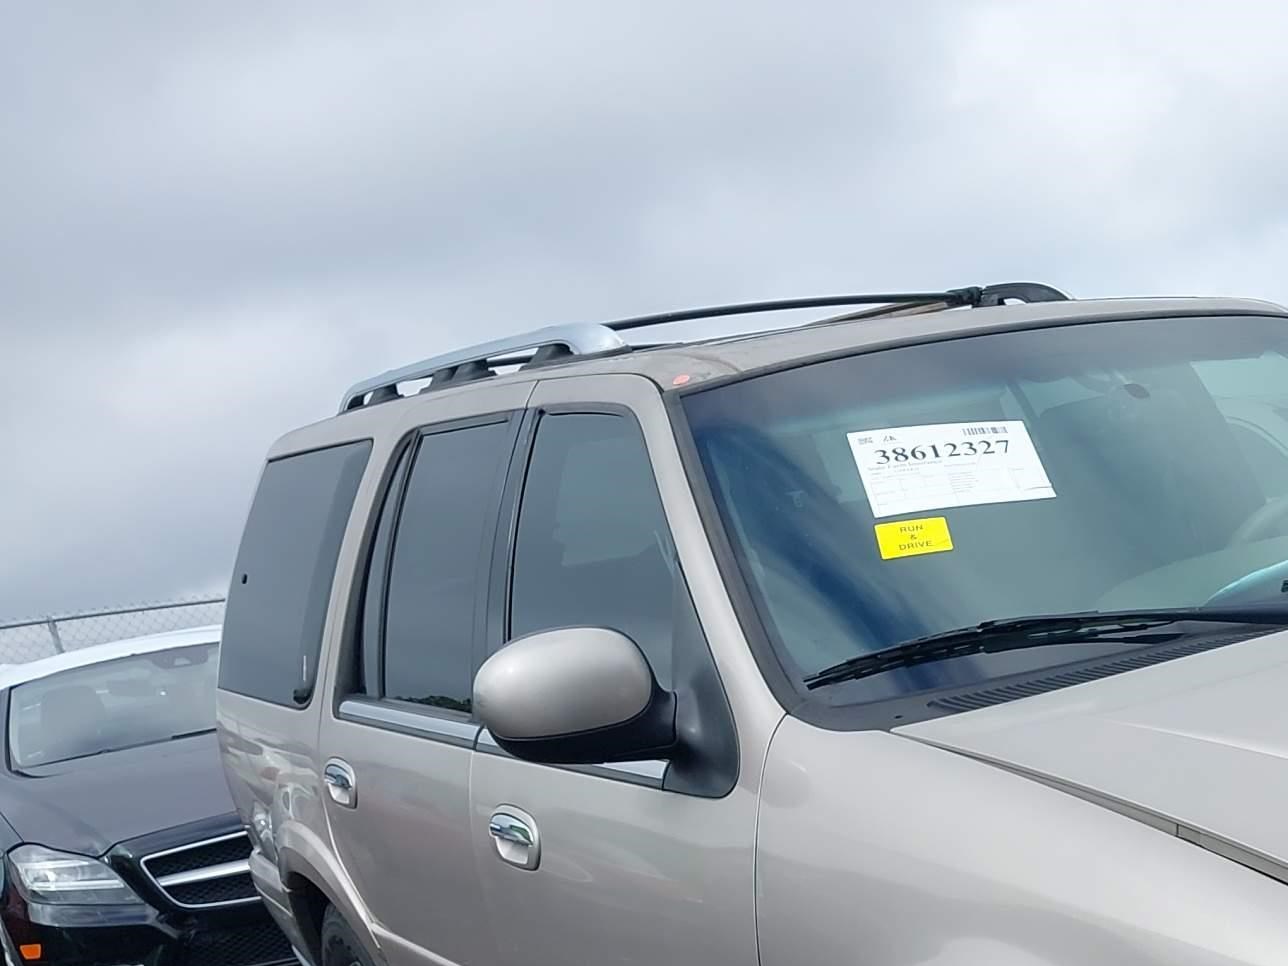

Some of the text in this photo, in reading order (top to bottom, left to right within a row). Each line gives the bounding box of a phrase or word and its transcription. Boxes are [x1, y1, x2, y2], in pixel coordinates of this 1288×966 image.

[873, 439, 1010, 465] 38612327
[899, 524, 925, 534] RUN
[898, 540, 933, 551] DRIVE
